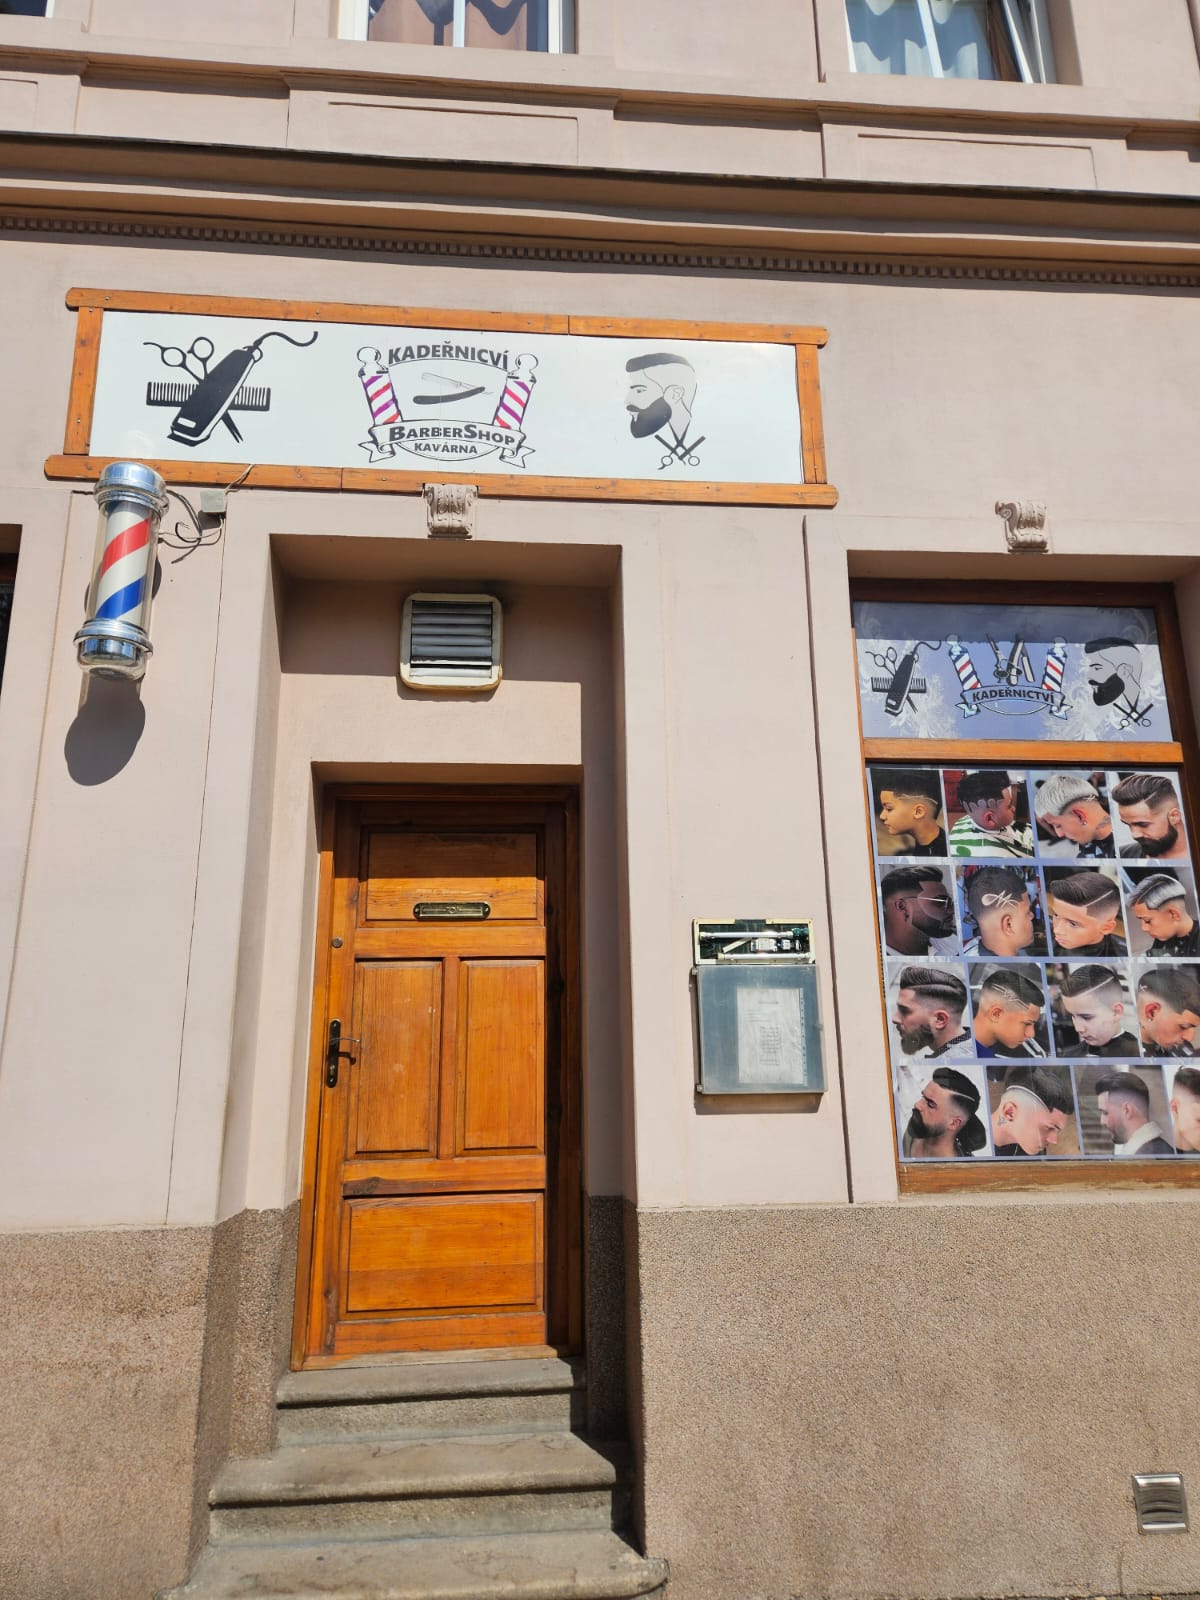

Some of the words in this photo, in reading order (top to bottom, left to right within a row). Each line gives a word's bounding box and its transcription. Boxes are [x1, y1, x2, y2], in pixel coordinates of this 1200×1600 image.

[388, 341, 509, 370] KADEŘNICVÍ
[414, 441, 478, 454] KAVÁRNA
[972, 686, 1055, 704] KADEŘNICTVÍ
